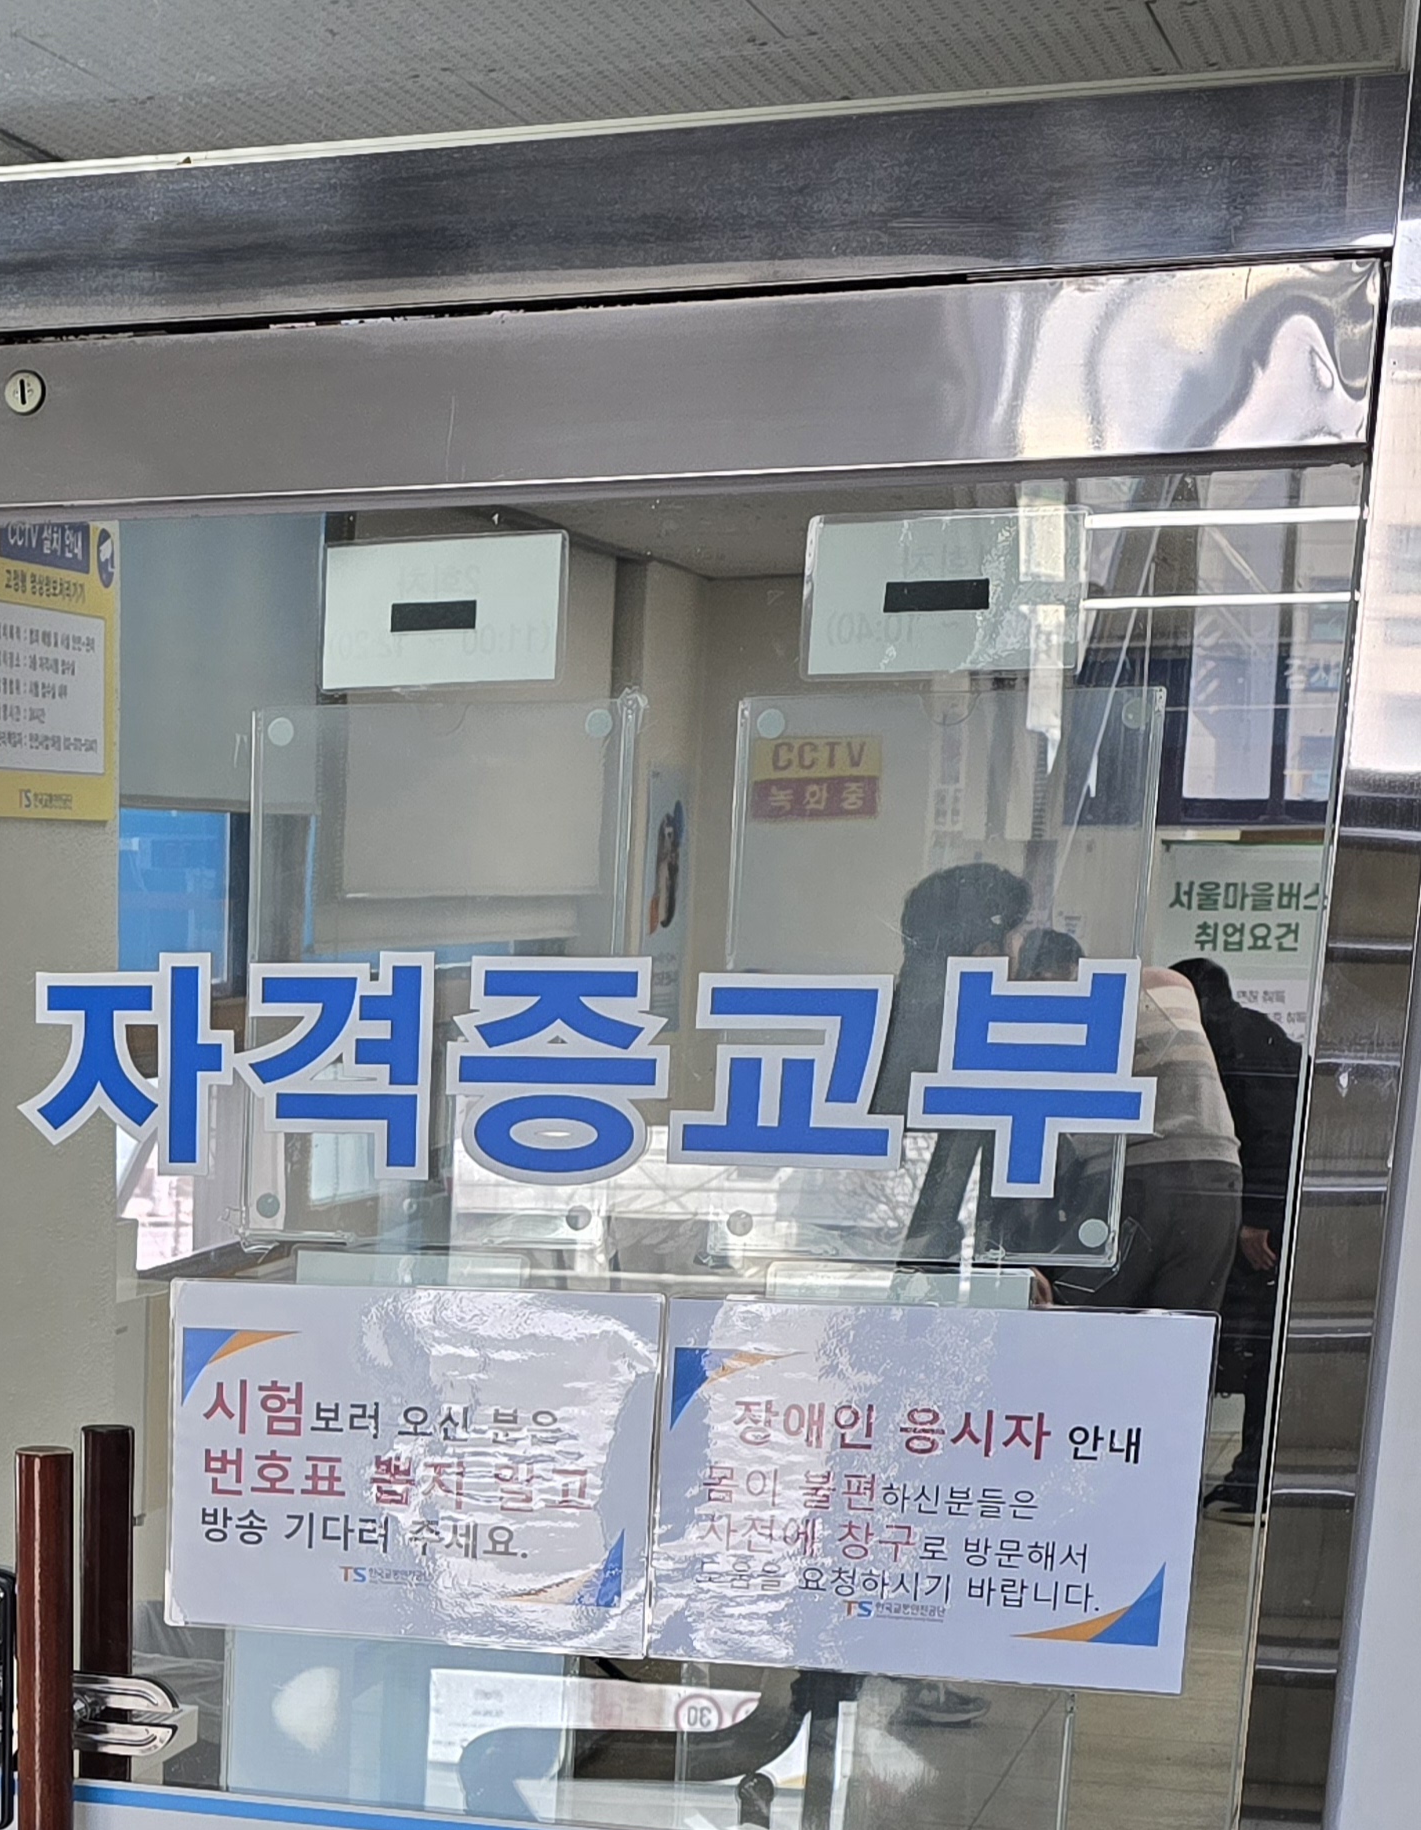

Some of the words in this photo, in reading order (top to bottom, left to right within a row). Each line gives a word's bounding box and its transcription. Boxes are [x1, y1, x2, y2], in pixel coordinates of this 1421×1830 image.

[64, 525, 83, 560] 안내
[772, 741, 866, 772] CCTV
[1169, 879, 1327, 912] 서울마을버스
[1195, 921, 1300, 952] 취업요건
[18, 951, 1157, 1199] 자격증교부
[202, 1378, 380, 1440] 시험보러
[397, 1404, 471, 1442] 오신
[733, 1400, 875, 1450] 장애인
[898, 1406, 1052, 1462] 응시자
[1067, 1425, 1144, 1464] 안내
[202, 1446, 347, 1499] 번호표
[370, 1454, 466, 1511] 뽑지
[702, 1465, 779, 1508] 몸이
[799, 1470, 1039, 1521] 불편하신분들은
[200, 1507, 269, 1546] 방송
[283, 1512, 390, 1554] 기다려
[408, 1519, 529, 1559] 주세요.
[837, 1520, 949, 1564] 창구로
[964, 1538, 1090, 1575] 방문해서
[339, 1566, 367, 1583] TS
[799, 1566, 952, 1605] 요청하시기
[966, 1576, 1101, 1613] 바랍니다.
[843, 1600, 873, 1617] TS
